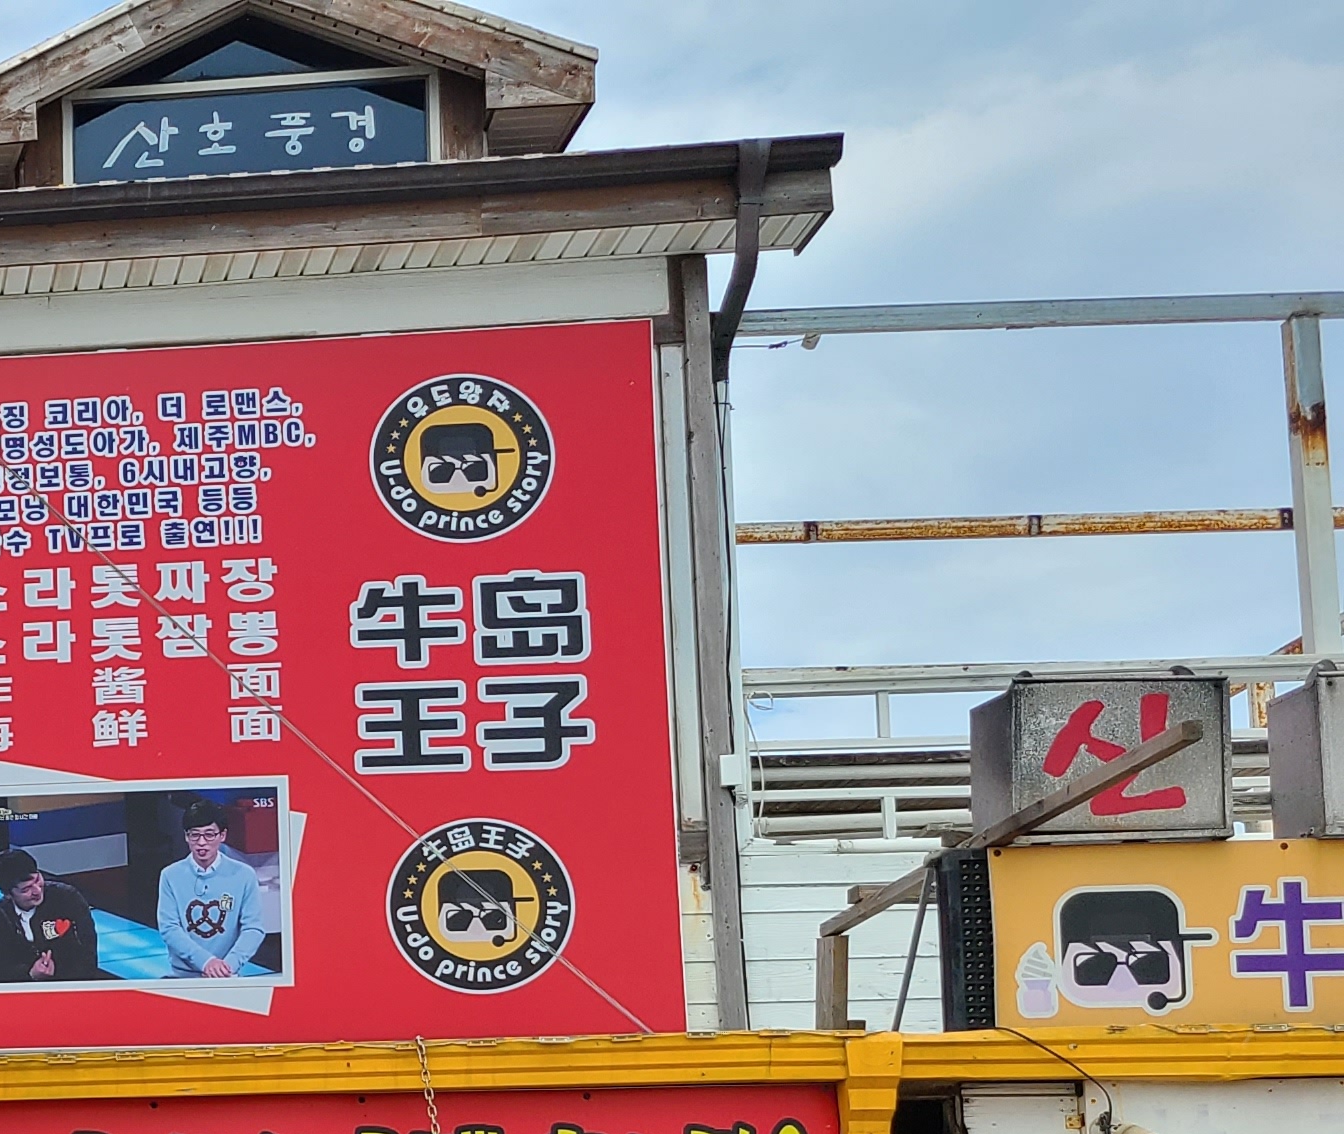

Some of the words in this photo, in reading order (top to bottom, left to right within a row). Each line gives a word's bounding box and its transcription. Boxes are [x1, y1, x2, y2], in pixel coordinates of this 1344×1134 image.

[103, 105, 375, 169] 산호풍경
[48, 398, 140, 425] 코리아,
[161, 396, 182, 418] 더
[205, 390, 300, 417] 로맨스,
[408, 379, 510, 416] 우도왕자
[177, 421, 313, 450] 제주MBC,
[122, 455, 269, 483] 6시내고향,
[68, 490, 179, 519] 대한민국
[201, 486, 254, 512] 등등
[379, 459, 418, 516] U-do
[417, 507, 504, 530] prince
[503, 448, 549, 516] story
[49, 523, 142, 551] TV프로
[164, 518, 259, 546] 출연!!!
[356, 577, 585, 663] 牛岛
[359, 680, 590, 769] 王子
[252, 797, 275, 808] SBS
[398, 904, 435, 964] U-do
[434, 955, 523, 982] prince
[521, 899, 569, 963] story
[1234, 882, 1344, 1006] 牛
